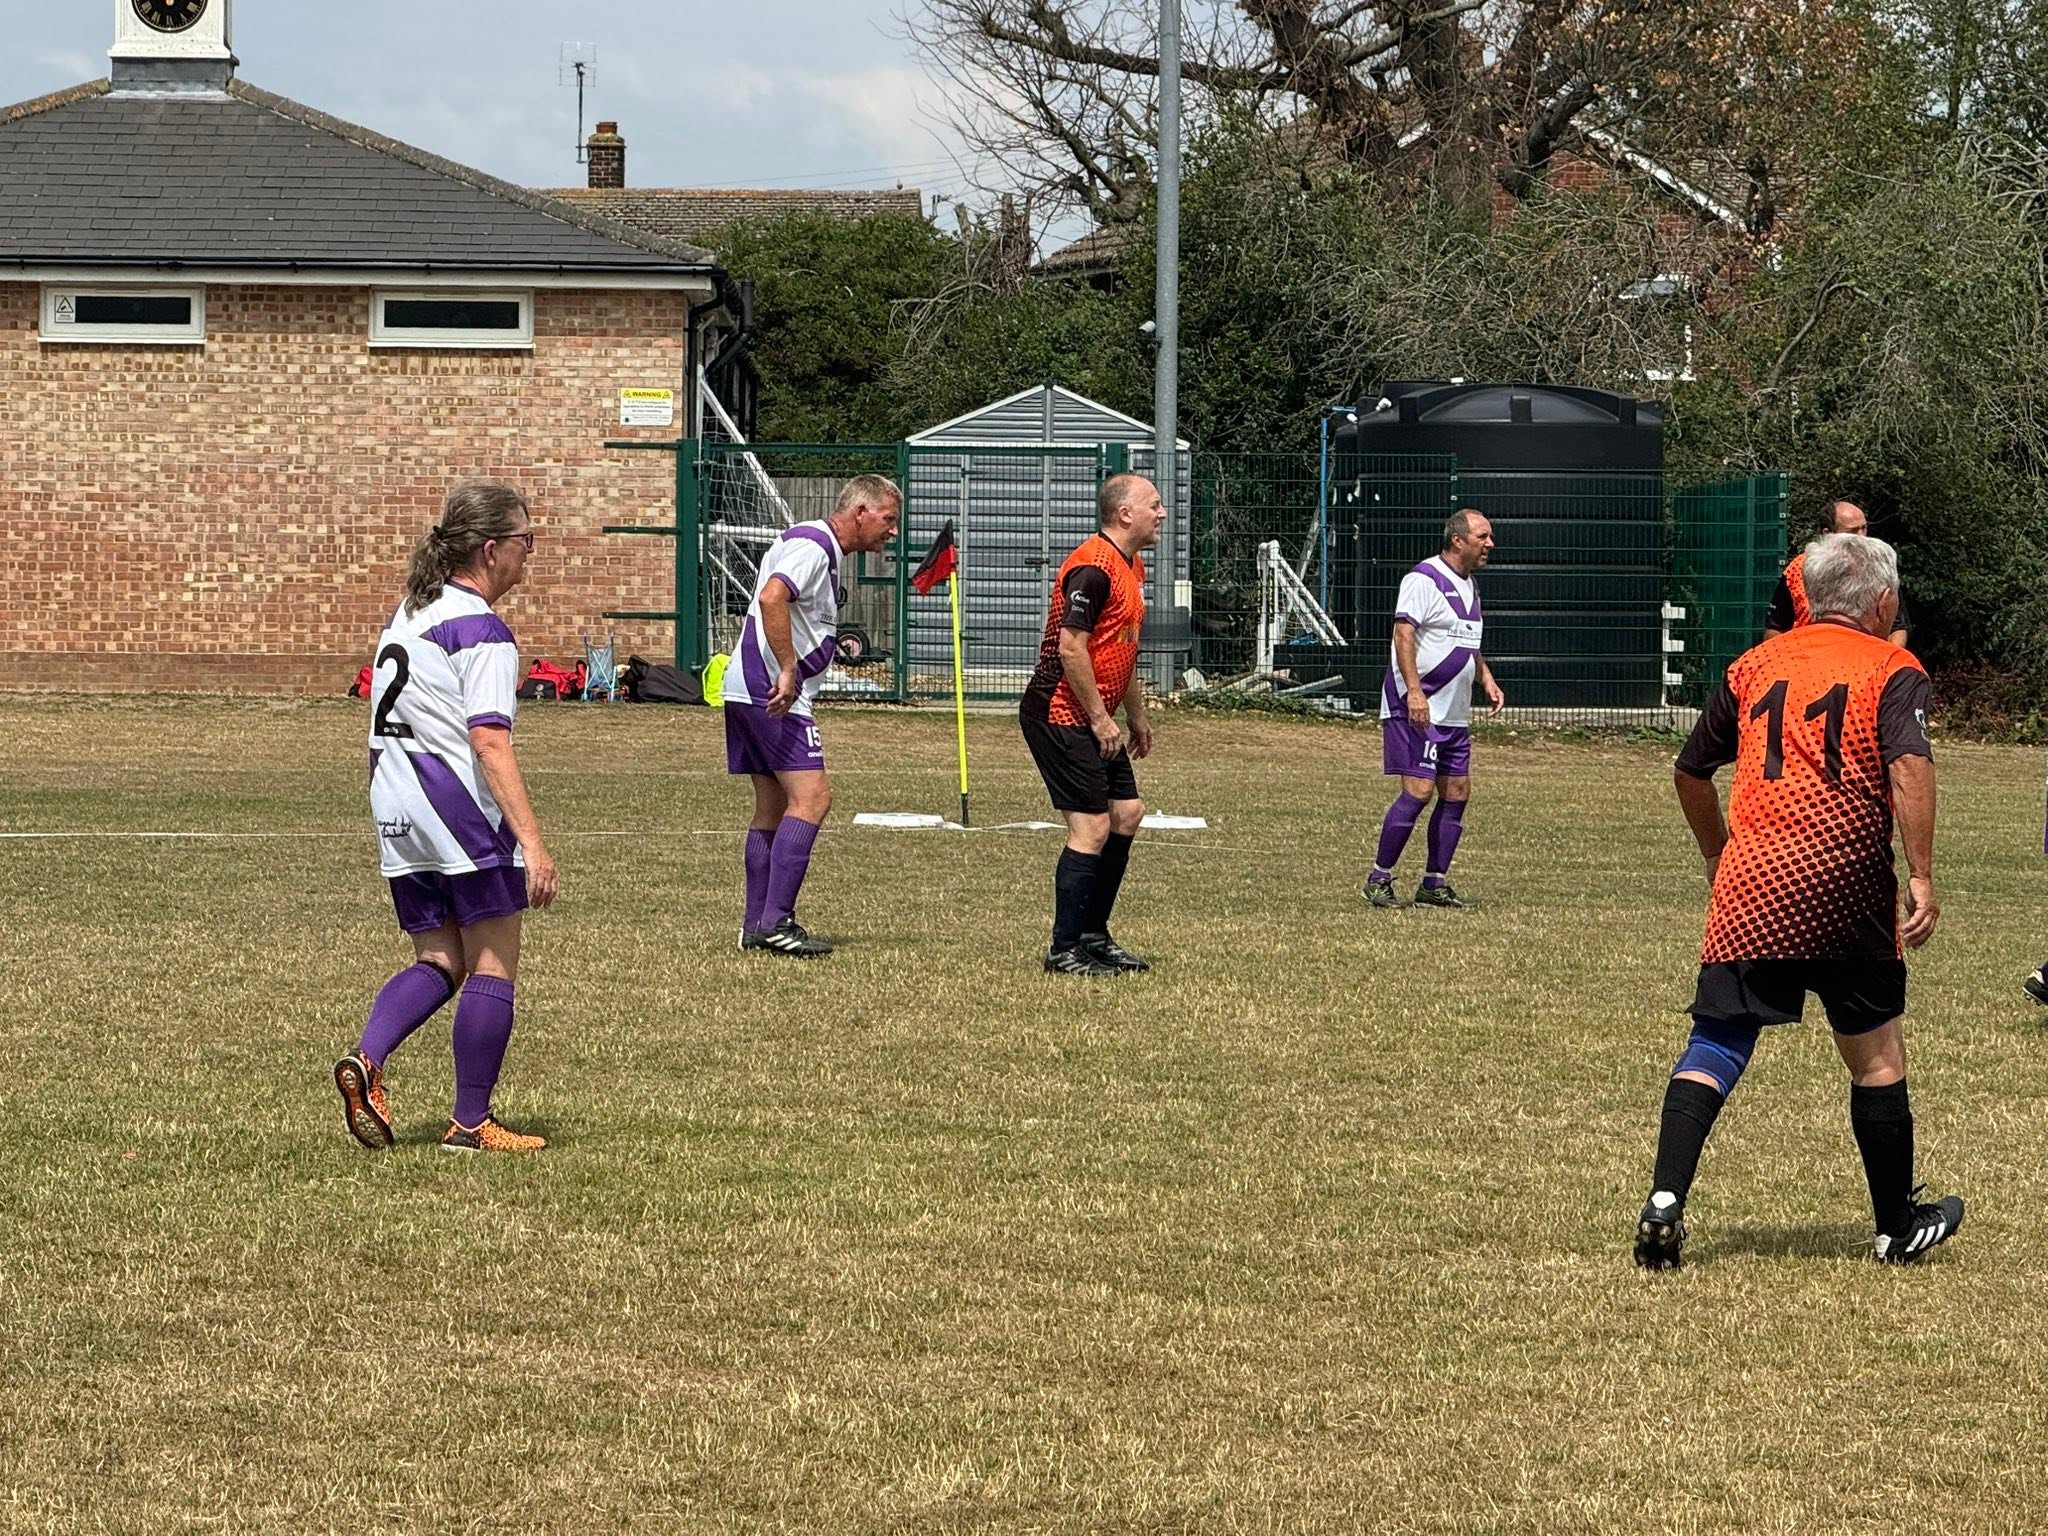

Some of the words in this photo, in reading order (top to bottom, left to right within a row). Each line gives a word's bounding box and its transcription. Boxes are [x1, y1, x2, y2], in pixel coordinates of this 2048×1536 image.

[375, 643, 415, 739] 2
[805, 726, 822, 747] 15
[1423, 740, 1437, 761] 16
[1750, 680, 1849, 787] 11
